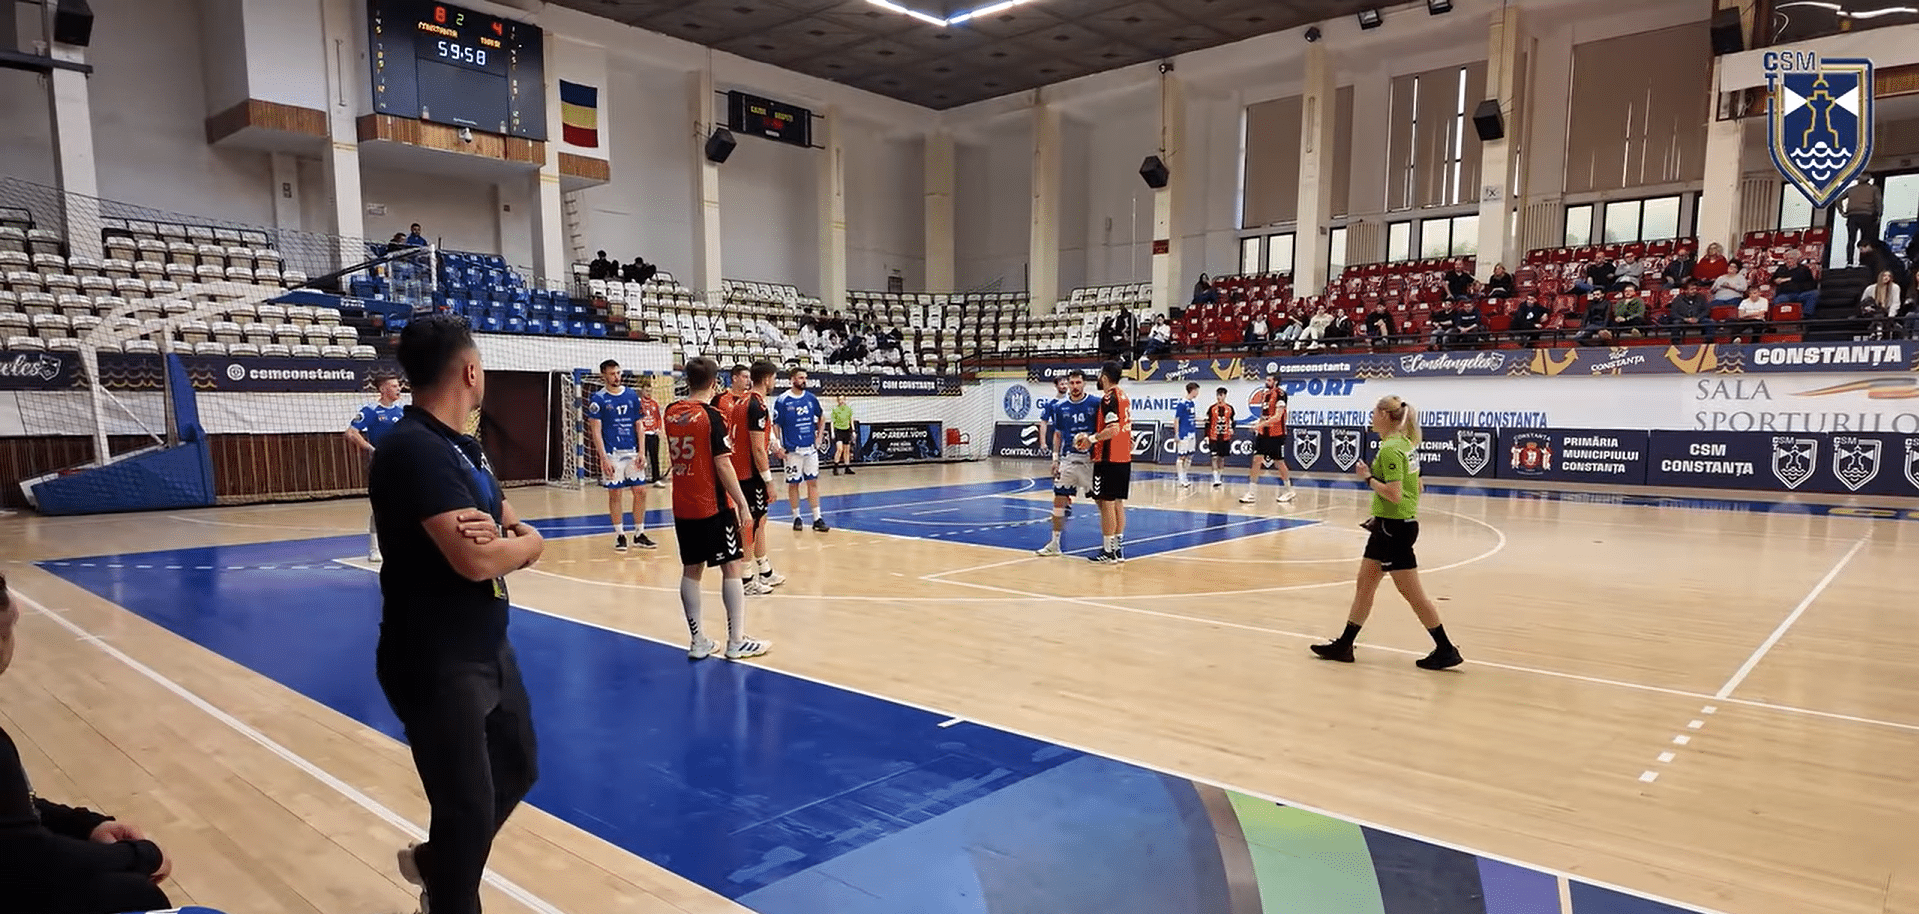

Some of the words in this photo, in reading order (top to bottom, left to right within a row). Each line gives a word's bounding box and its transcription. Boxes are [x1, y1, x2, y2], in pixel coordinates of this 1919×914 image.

[455, 13, 465, 26] 2
[491, 22, 503, 36] 4
[1753, 344, 1902, 366] CONSTANȚA
[249, 368, 355, 380] csmconstanta
[1280, 362, 1350, 373] csmconstanta
[1281, 378, 1365, 396] PORT
[1696, 379, 1772, 400] SALA
[616, 404, 628, 415] 17
[1072, 413, 1086, 424] 14
[1287, 411, 1324, 425] IRECTIA
[1327, 411, 1366, 425] PENTRU
[1479, 411, 1547, 428] CONSTANTA
[1563, 435, 1619, 447] PRIMĂRIA
[1833, 437, 1857, 445] CSM
[1905, 438, 1919, 446] CS
[669, 436, 695, 460] 35
[1689, 443, 1726, 456] CSM
[1562, 449, 1640, 461] MUNICIPIULUI
[1562, 461, 1625, 474] CONSTANȚA
[1661, 460, 1754, 476] CONSTANȚA
